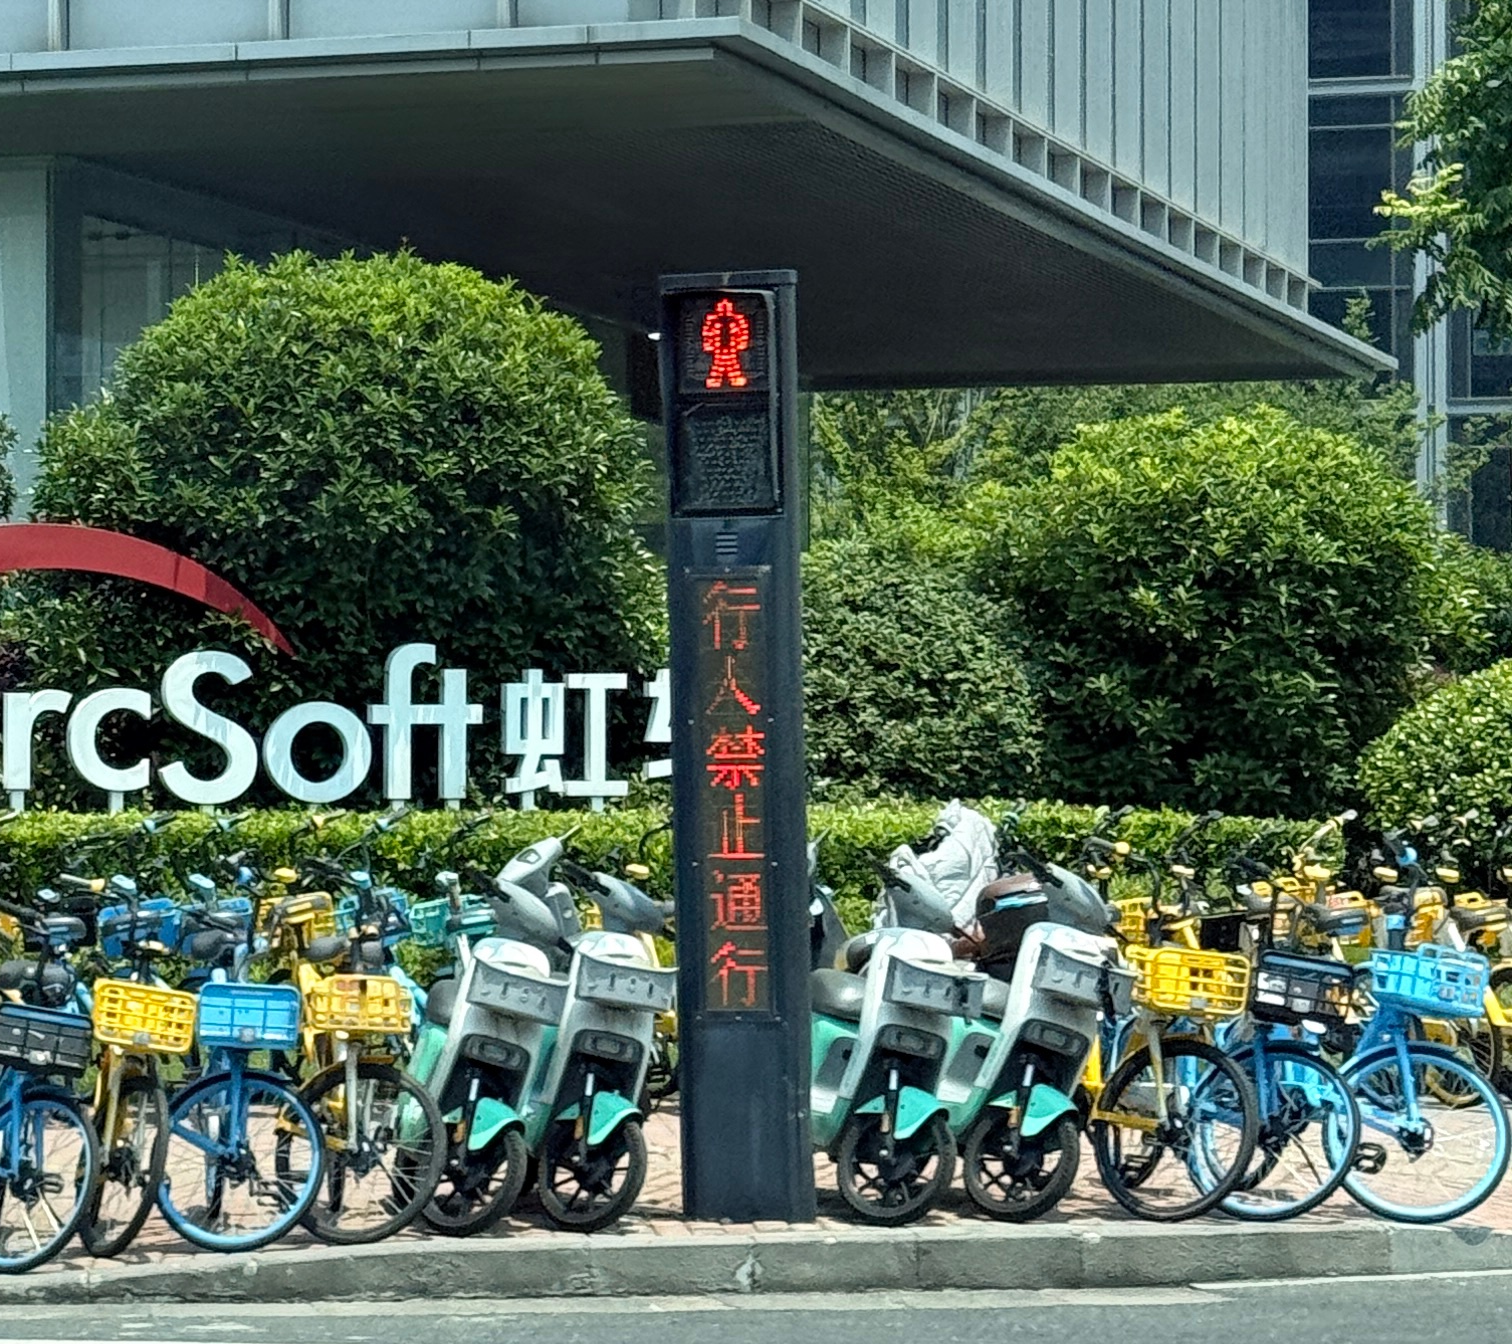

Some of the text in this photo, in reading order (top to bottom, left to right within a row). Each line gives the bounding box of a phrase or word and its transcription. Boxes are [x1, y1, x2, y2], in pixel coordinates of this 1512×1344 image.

[702, 580, 769, 1006] 行人禁止通行
